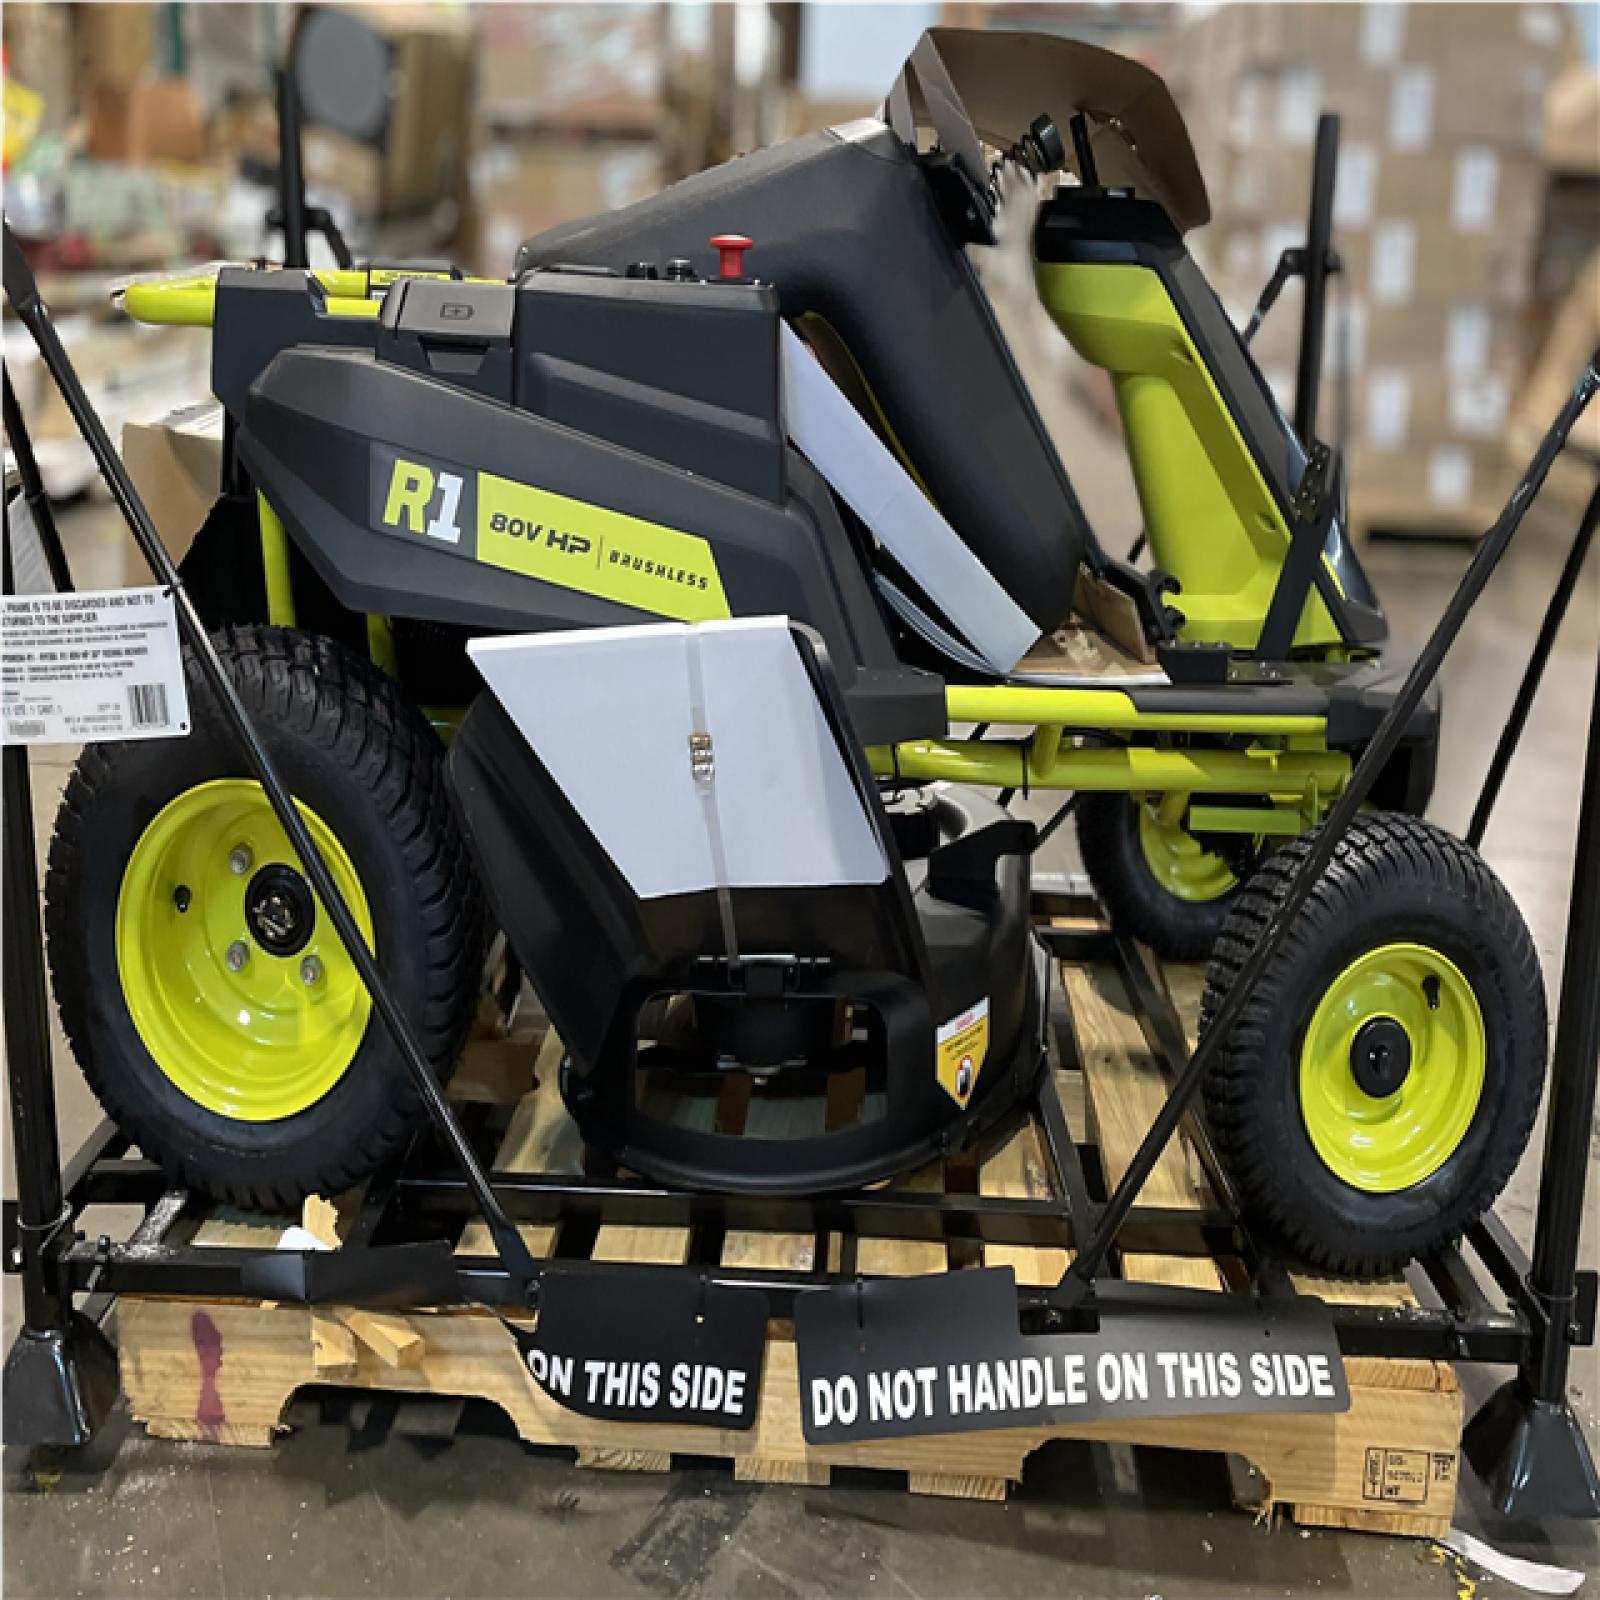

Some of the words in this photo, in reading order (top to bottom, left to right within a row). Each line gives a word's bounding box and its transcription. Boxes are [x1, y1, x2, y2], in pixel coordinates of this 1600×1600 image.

[382, 459, 464, 544] R1
[489, 512, 543, 542] 80V
[546, 529, 591, 554] HP
[609, 550, 709, 590] BRUSHLESS
[527, 1349, 575, 1397] ON
[584, 1360, 662, 1409] THIS
[669, 1362, 747, 1415] SIDE
[811, 1374, 860, 1428] DO
[867, 1366, 938, 1422] NOT
[947, 1353, 1089, 1415] HANDLE
[1097, 1351, 1149, 1402] ON
[1156, 1351, 1242, 1398] THIS
[1249, 1353, 1336, 1397] SIDE
